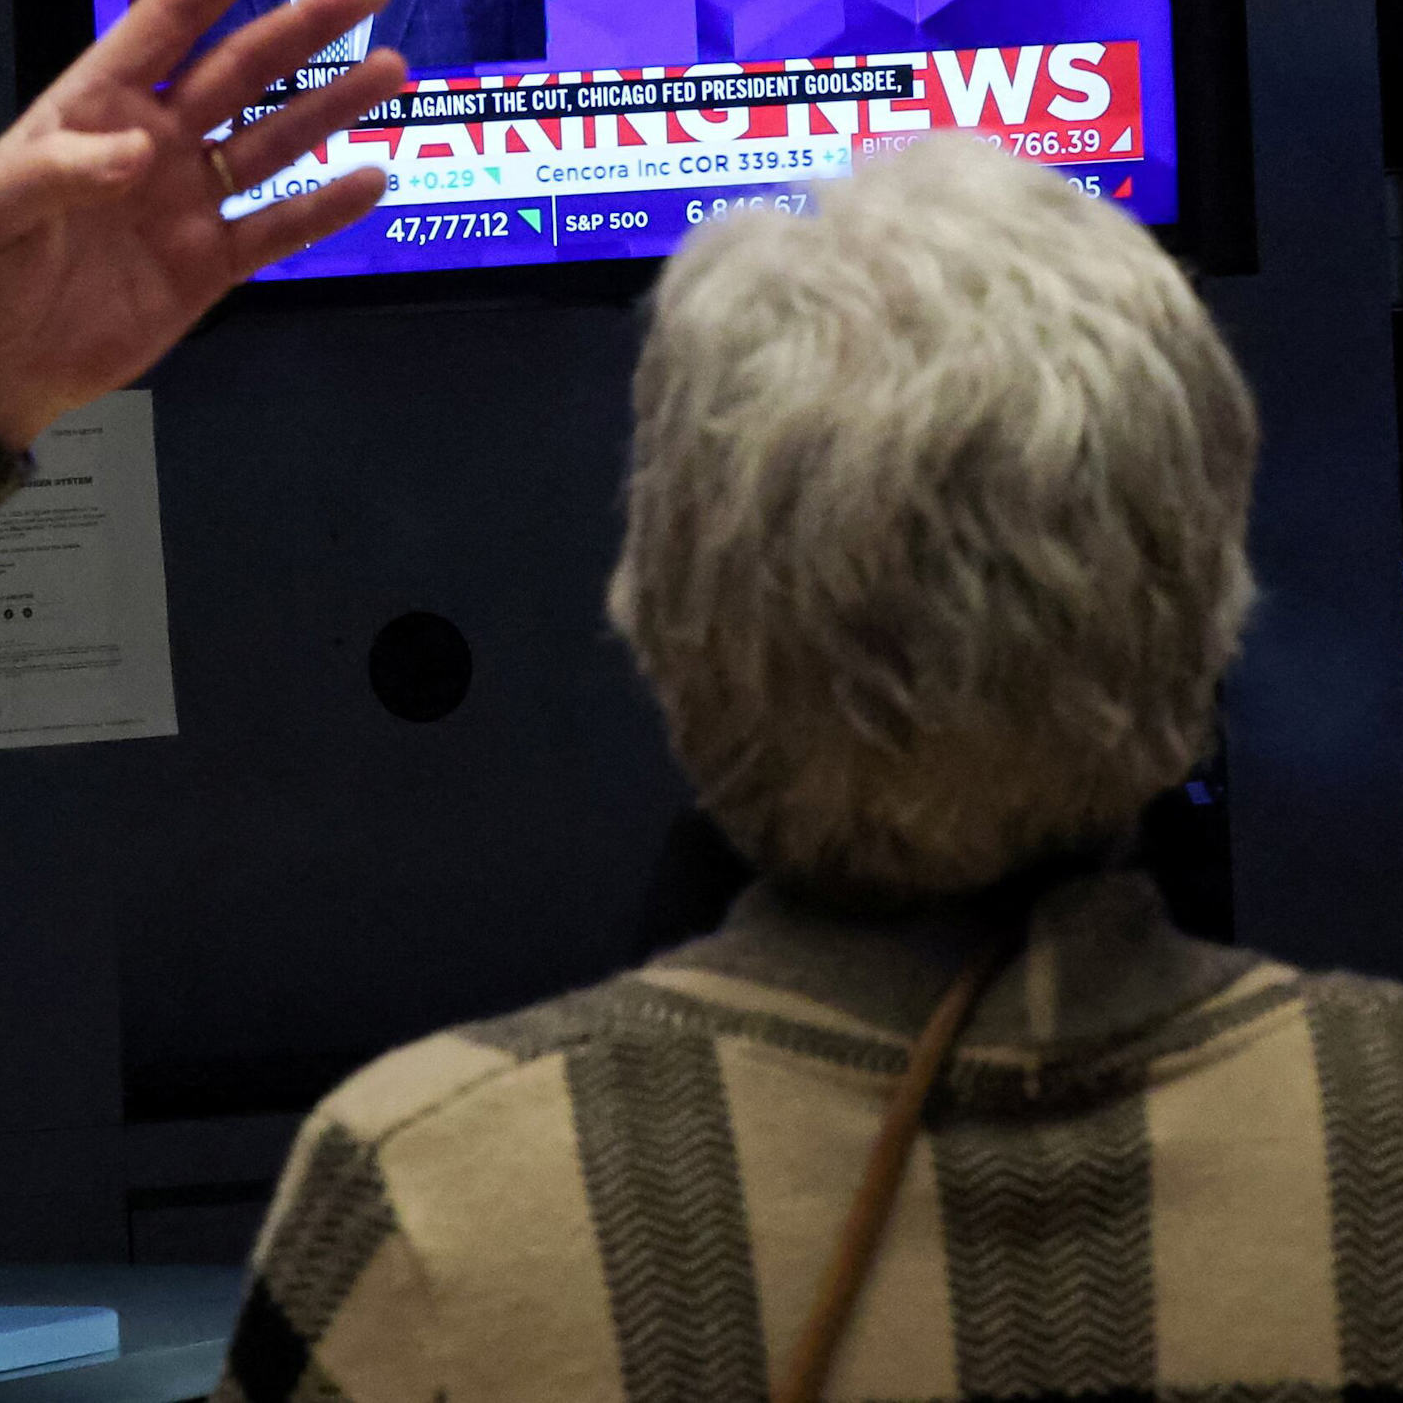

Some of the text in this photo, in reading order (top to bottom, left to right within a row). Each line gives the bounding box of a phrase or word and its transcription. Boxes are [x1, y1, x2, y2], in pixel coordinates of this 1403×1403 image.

[358, 68, 902, 122] 019. AGAINST THE CUT, CHICAGO FED PRESIDENT GOOLSBEE,
[785, 42, 1112, 138] NEWS
[862, 135, 919, 155] BITC
[408, 169, 475, 190] +0.29
[536, 160, 632, 184] Cencora
[638, 158, 671, 178] Inc
[679, 154, 729, 174] COR
[738, 149, 814, 171] 339.35
[385, 211, 509, 246] 47,777.12
[565, 214, 604, 233] S&P
[609, 210, 649, 230] 500
